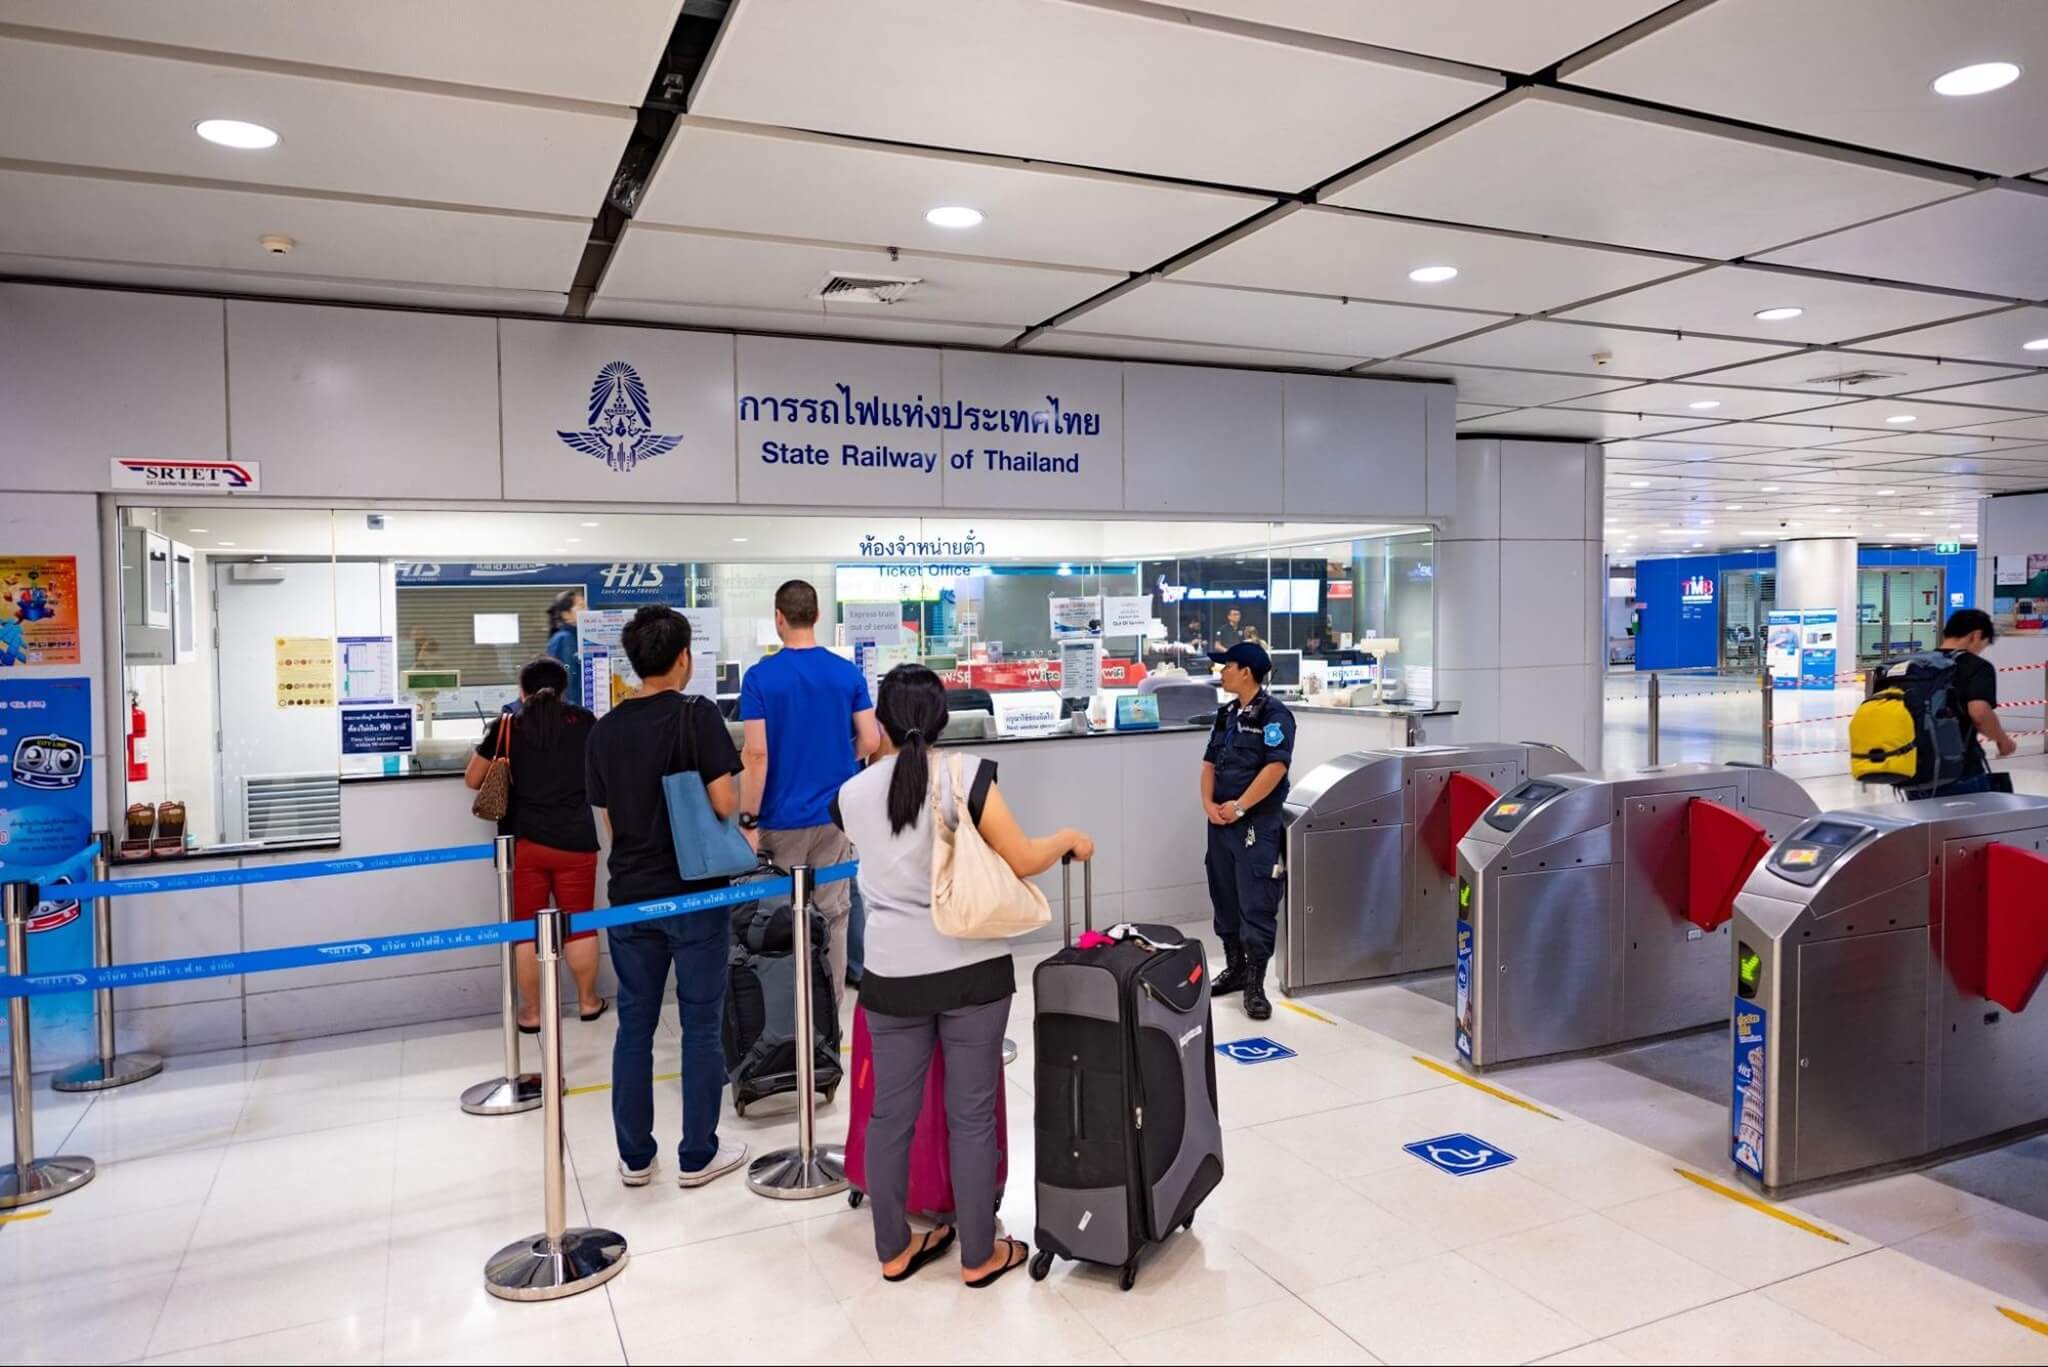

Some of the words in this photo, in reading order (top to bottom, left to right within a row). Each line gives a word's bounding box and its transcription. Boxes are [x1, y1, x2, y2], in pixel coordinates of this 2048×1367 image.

[739, 382, 1100, 436] การรถไฟแห่งประเทศไทย
[761, 441, 829, 465] State
[842, 444, 937, 473] Railway
[951, 450, 974, 469] of
[984, 449, 1080, 472] Thailand
[146, 467, 221, 481] SRTET
[859, 529, 986, 556] ห้องจำหน่ายตั๋ว
[879, 564, 922, 577] Ticket
[928, 564, 971, 577] Office
[1680, 576, 1713, 596] TMB
[380, 723, 391, 731] 90
